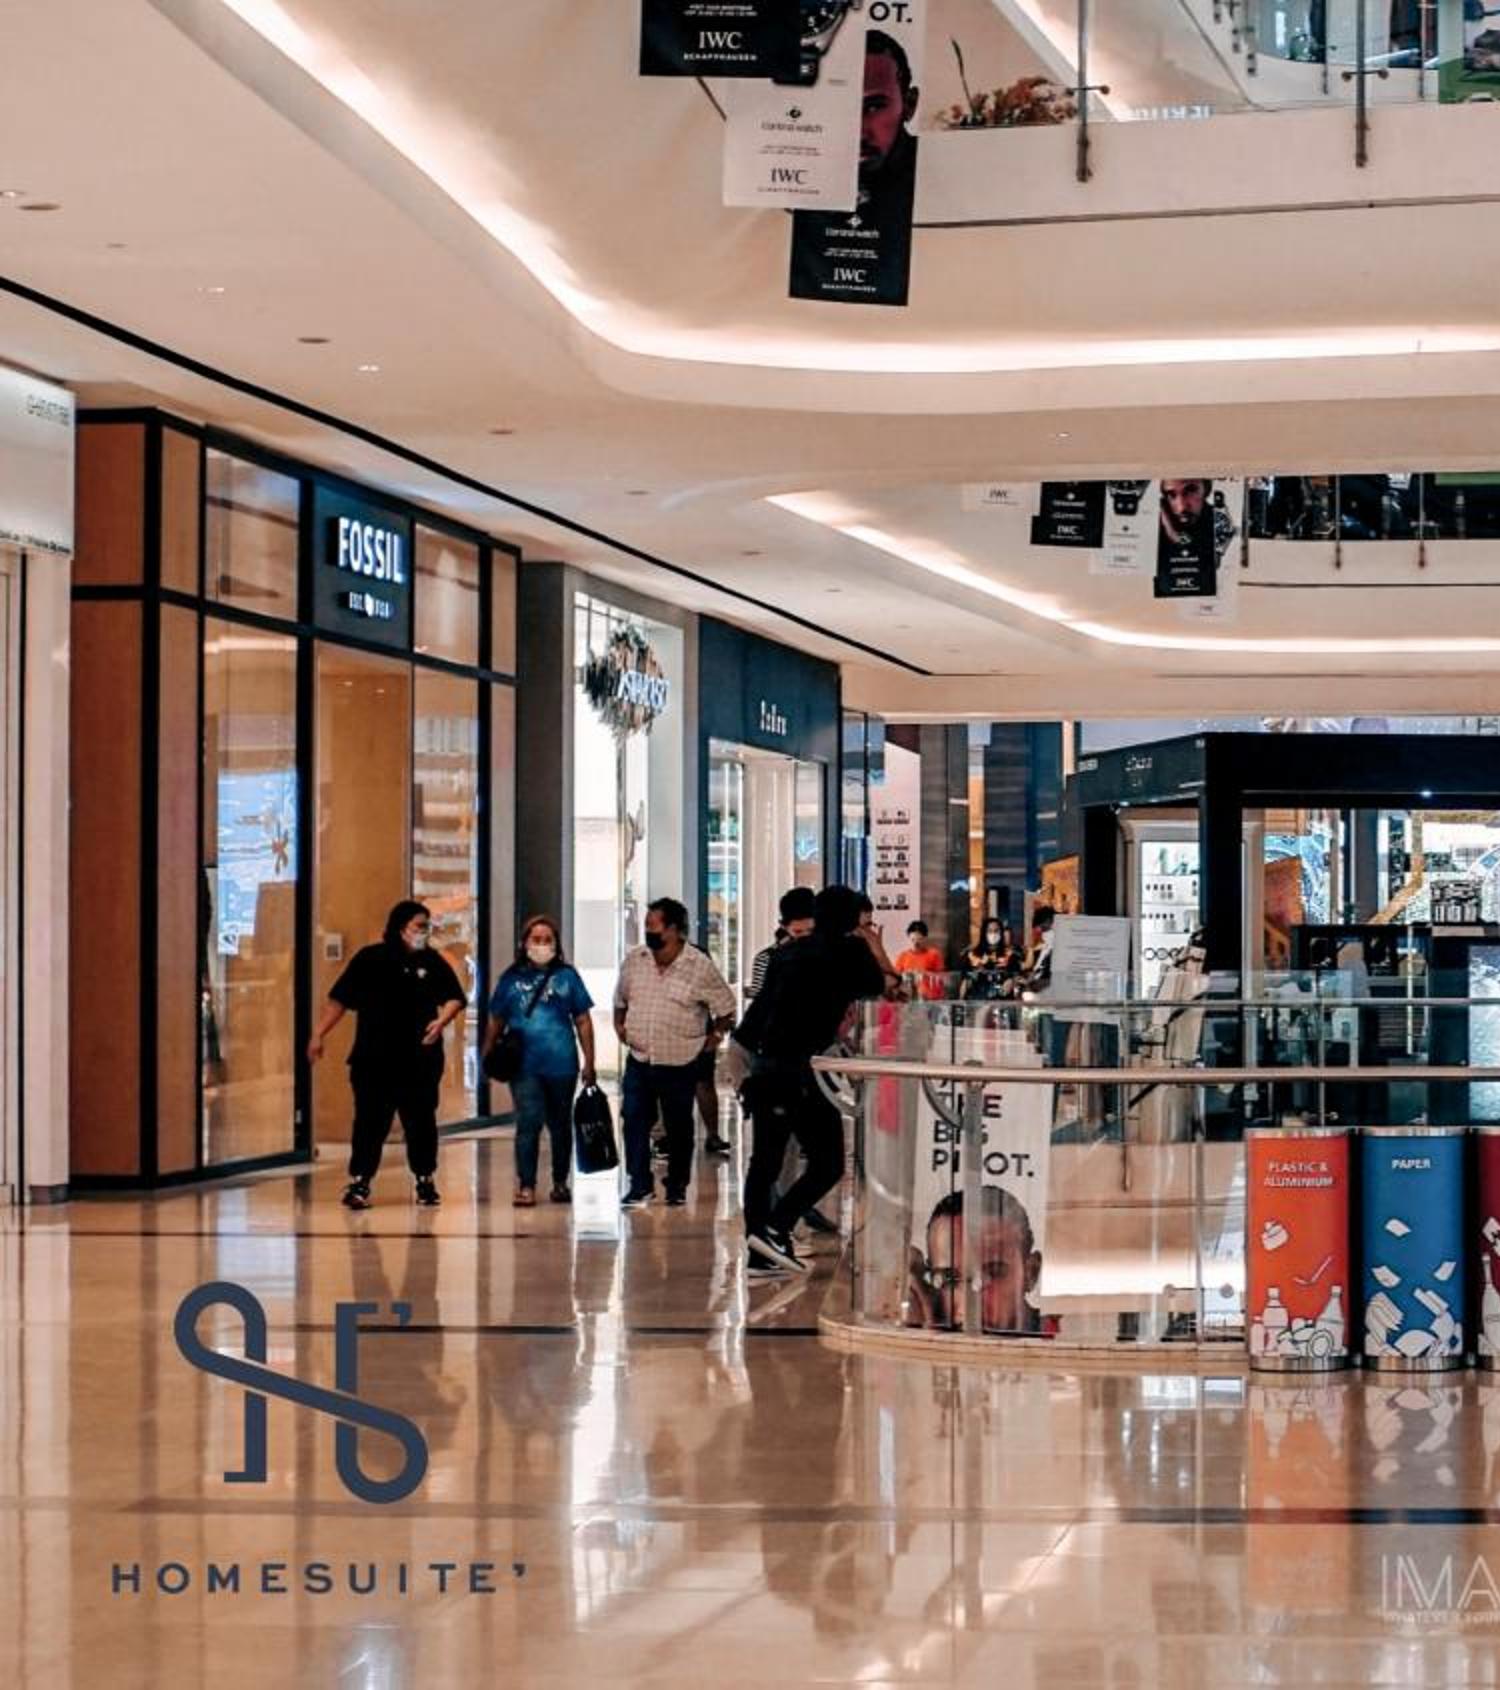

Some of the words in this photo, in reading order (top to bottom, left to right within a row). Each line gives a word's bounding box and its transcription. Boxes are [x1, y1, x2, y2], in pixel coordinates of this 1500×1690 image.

[699, 31, 742, 49] IWC
[771, 168, 808, 184] IWC
[834, 267, 867, 283] IWC
[339, 516, 404, 583] FOSSIL
[1268, 1161, 1312, 1173] PLASTIC
[1392, 1158, 1431, 1169] PAPER
